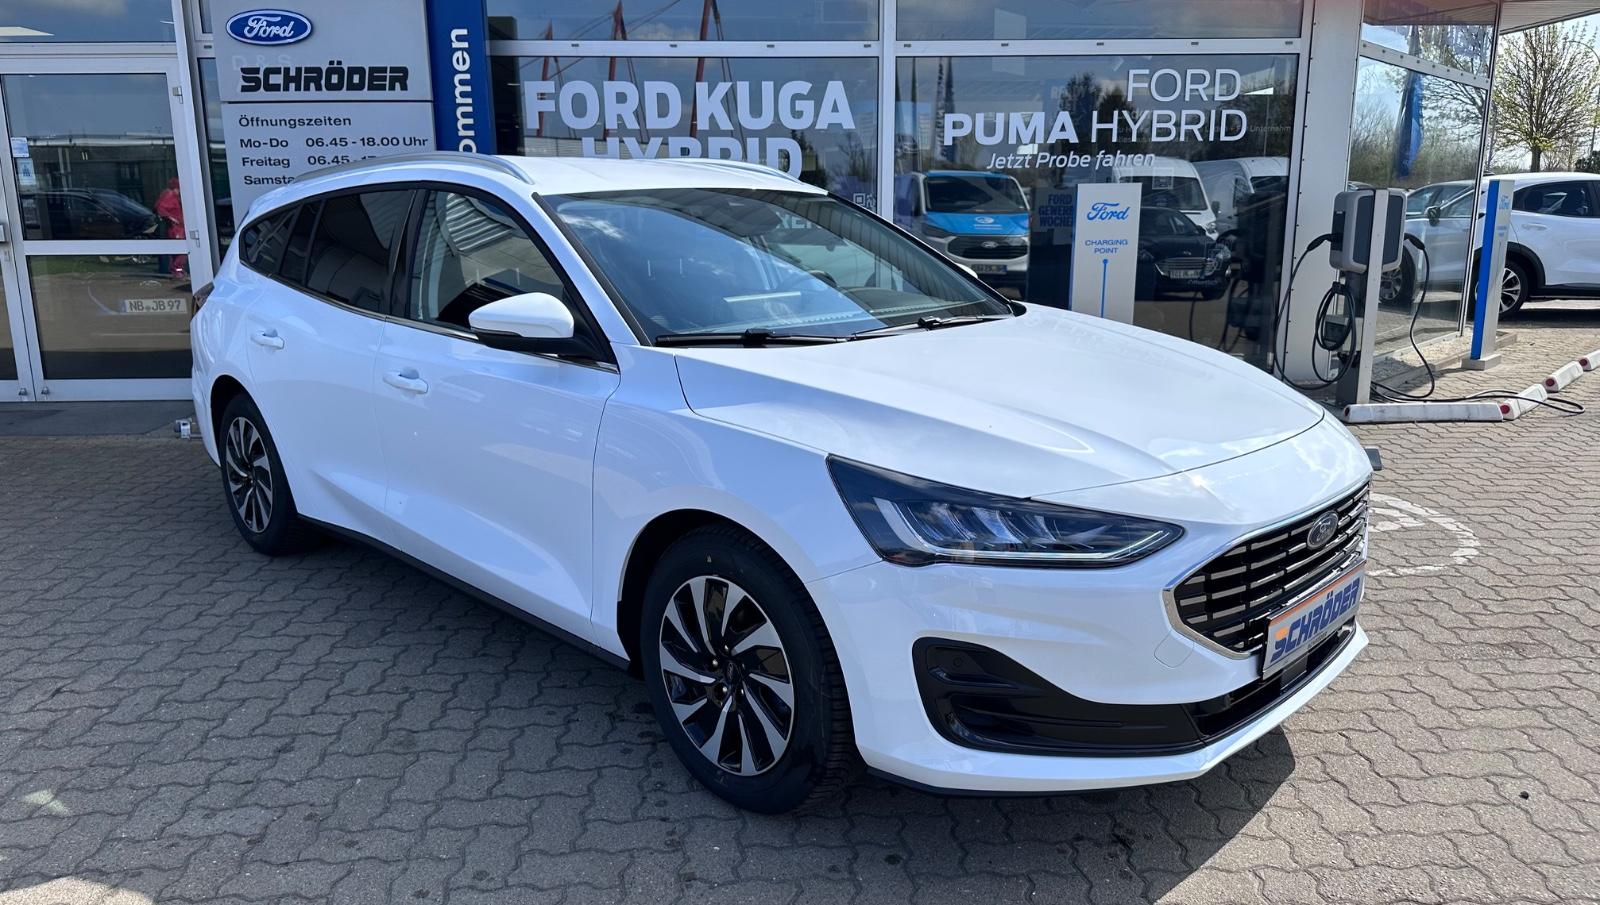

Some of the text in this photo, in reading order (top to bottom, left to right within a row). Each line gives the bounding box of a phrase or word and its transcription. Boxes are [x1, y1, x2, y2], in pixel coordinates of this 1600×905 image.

[244, 15, 295, 38] Ford
[239, 60, 409, 93] SCHRÖDER
[1124, 68, 1242, 102] FORD
[524, 80, 856, 131] FORD KUGA
[238, 115, 352, 129] Öffnungszeiten
[943, 109, 1248, 146] PUMA HYBRID
[239, 138, 289, 148] Mo-Do
[402, 136, 429, 147] Uhr
[241, 156, 291, 168] Freitag
[986, 150, 1156, 170] Jetzt Probe fahren
[1086, 202, 1131, 221] Ford
[1084, 239, 1128, 247] CHARGING
[1094, 247, 1119, 255] POINT
[1270, 578, 1360, 664] SCHRÖDER
